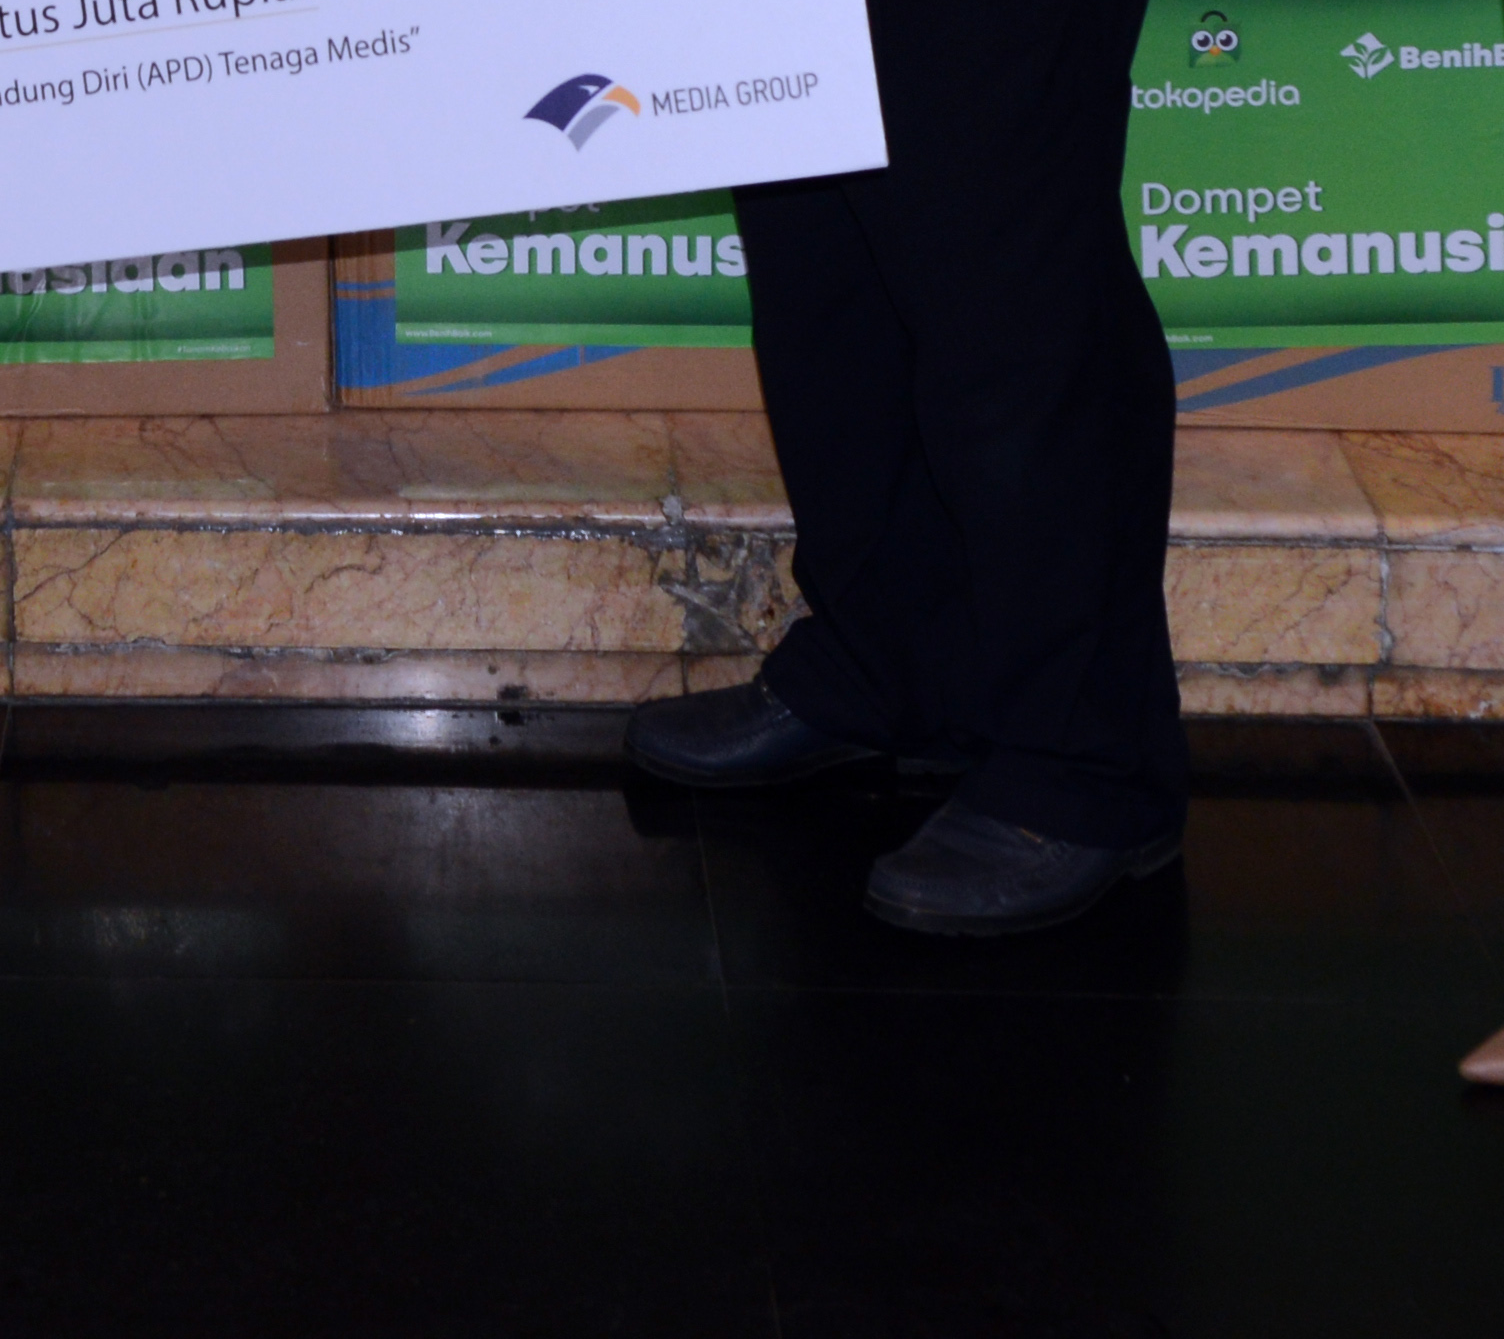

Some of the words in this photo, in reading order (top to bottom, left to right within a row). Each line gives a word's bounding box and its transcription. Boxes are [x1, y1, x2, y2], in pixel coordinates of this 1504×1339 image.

[82, 70, 129, 95] Diri
[138, 55, 212, 90] (APD)
[218, 47, 318, 76] Tenaga
[327, 27, 419, 62] Medis”
[651, 85, 729, 116] MEDIA
[735, 72, 818, 106] GROUP
[1132, 79, 1300, 114] tokopedia
[1142, 181, 1322, 223] Dompet
